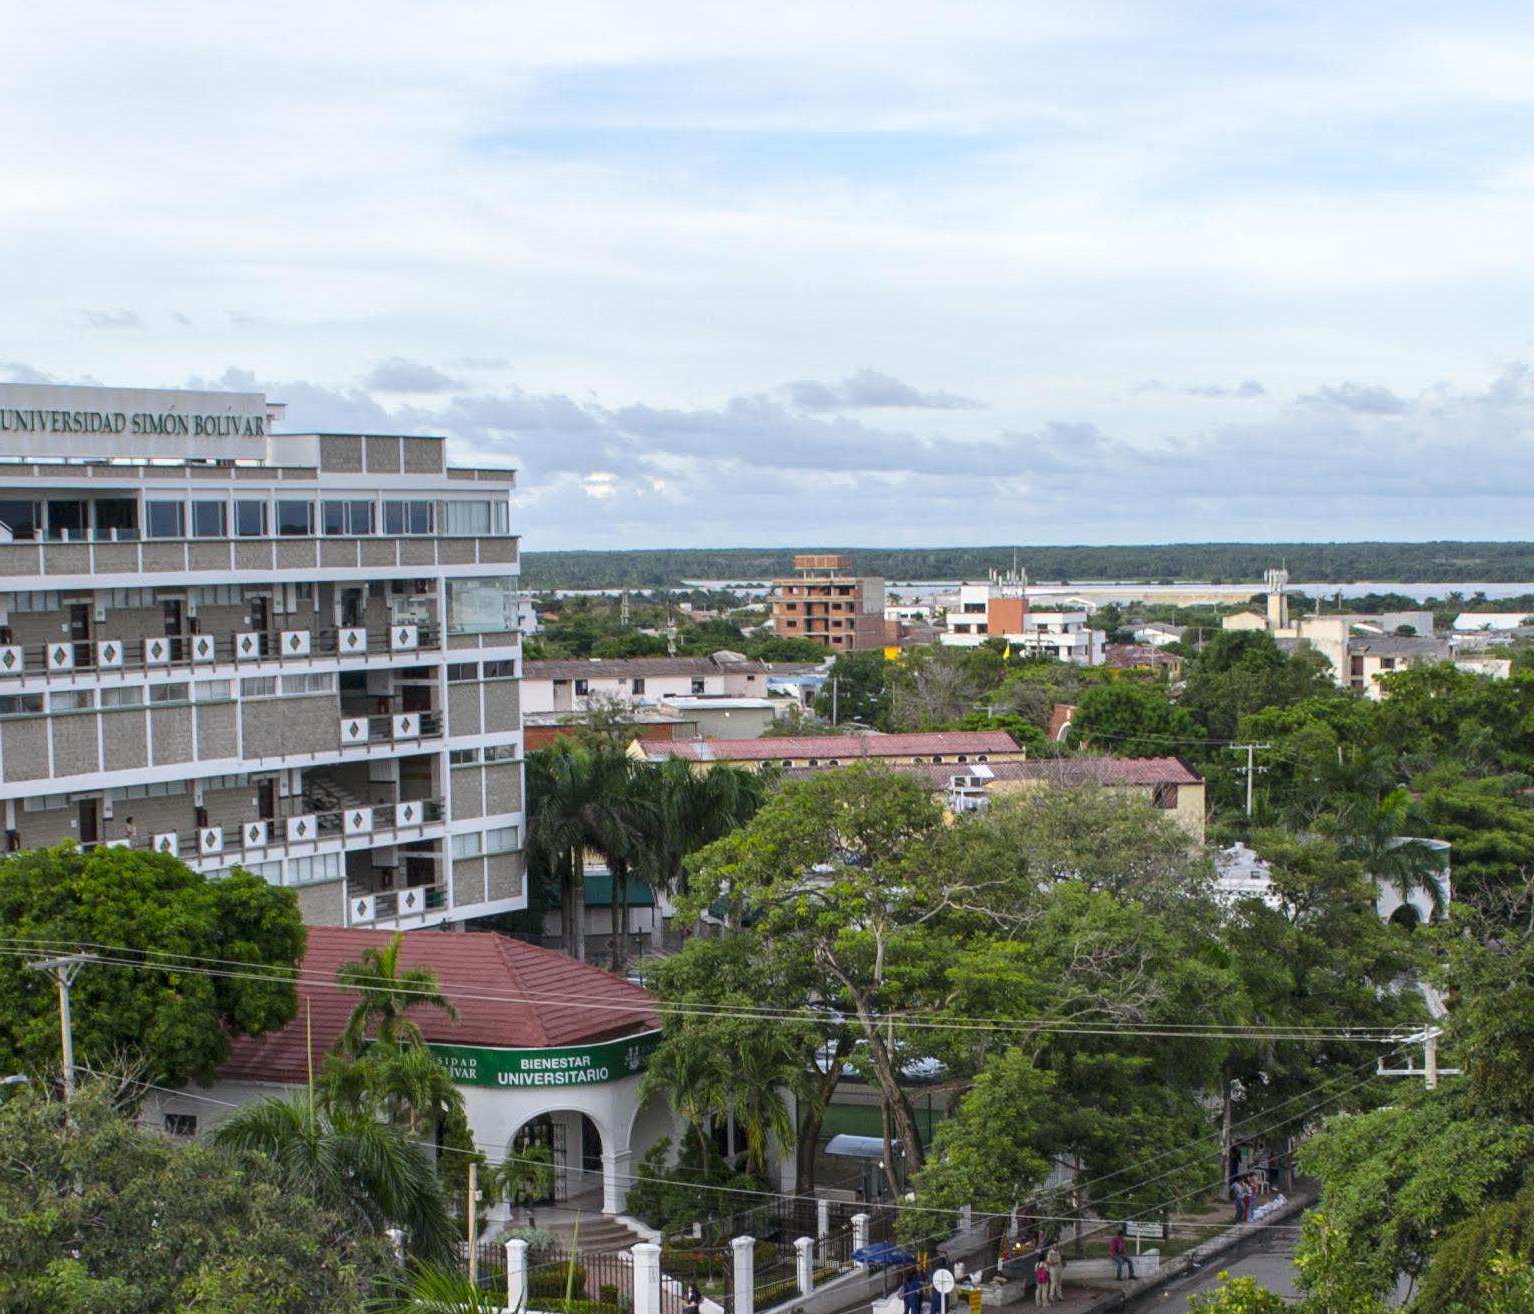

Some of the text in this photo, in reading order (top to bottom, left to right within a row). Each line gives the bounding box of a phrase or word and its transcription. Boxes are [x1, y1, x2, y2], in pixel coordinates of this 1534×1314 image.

[0, 404, 265, 437] UNIVERSIDAD SIMÓN BOLÍVAR
[520, 1055, 591, 1070] BIENESTAR
[498, 1068, 609, 1085] UNIVERSITARIO
